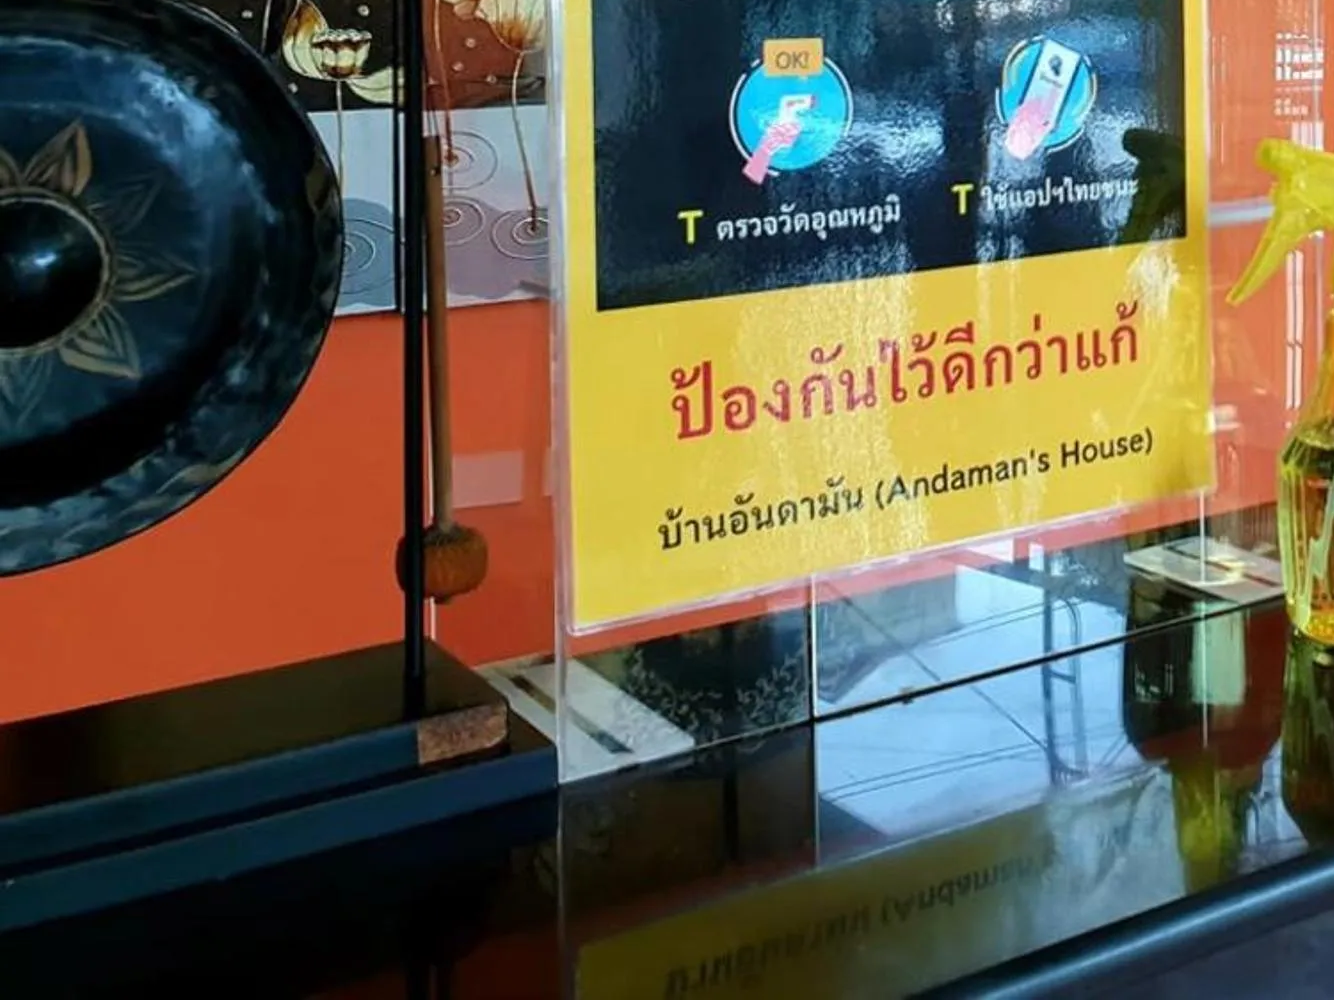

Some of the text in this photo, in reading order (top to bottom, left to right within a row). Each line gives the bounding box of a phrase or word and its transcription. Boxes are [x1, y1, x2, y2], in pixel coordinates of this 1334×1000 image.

[677, 193, 901, 244] T ตรวจวัดอุณหภูมิ
[950, 183, 974, 215] T
[669, 300, 1140, 441] ป้องกันไว้ดีกว่าแก้
[656, 427, 1154, 551] บ้านอันดามัน (Andaman's House)
